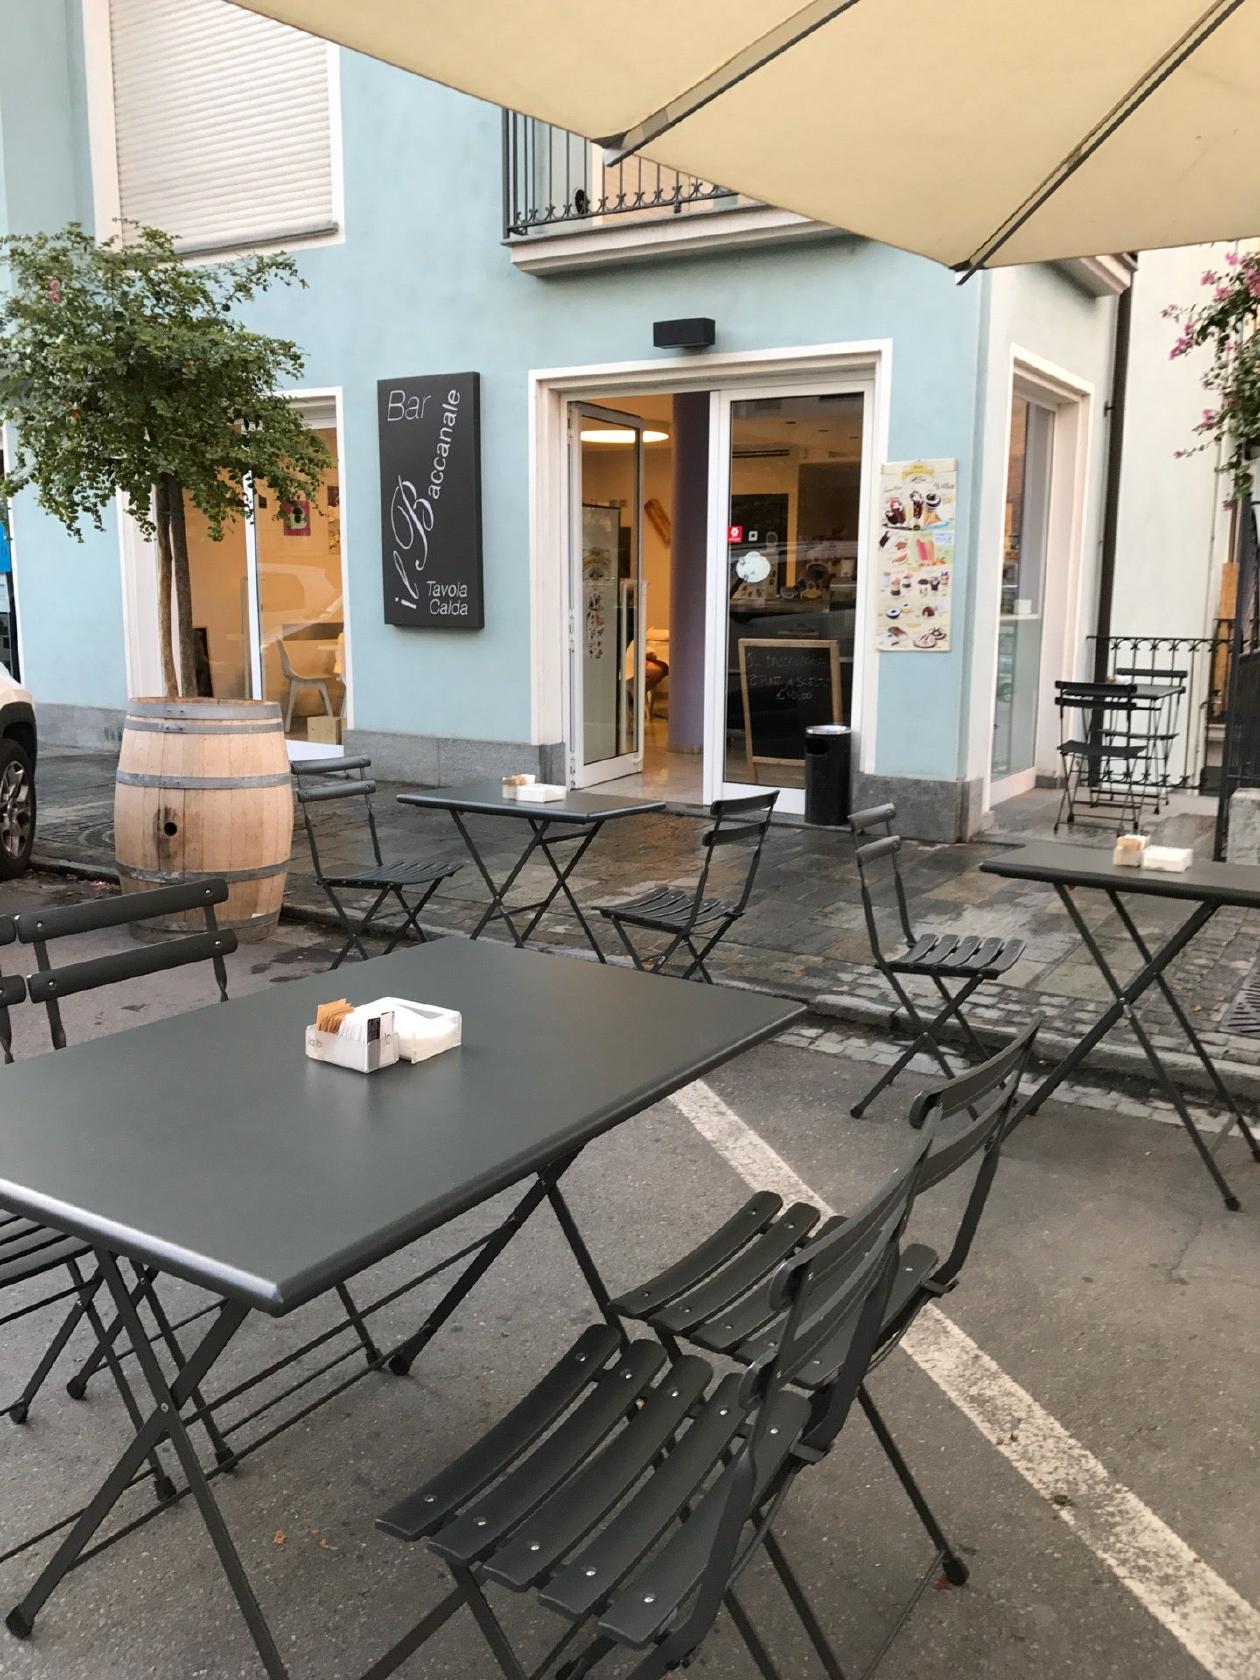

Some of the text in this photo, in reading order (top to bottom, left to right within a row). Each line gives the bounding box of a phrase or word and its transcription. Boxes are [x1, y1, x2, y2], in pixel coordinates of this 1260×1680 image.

[387, 389, 431, 422] Bar
[390, 389, 461, 571] Baccanale
[426, 580, 468, 598] Tavola
[429, 598, 469, 616] Calda
